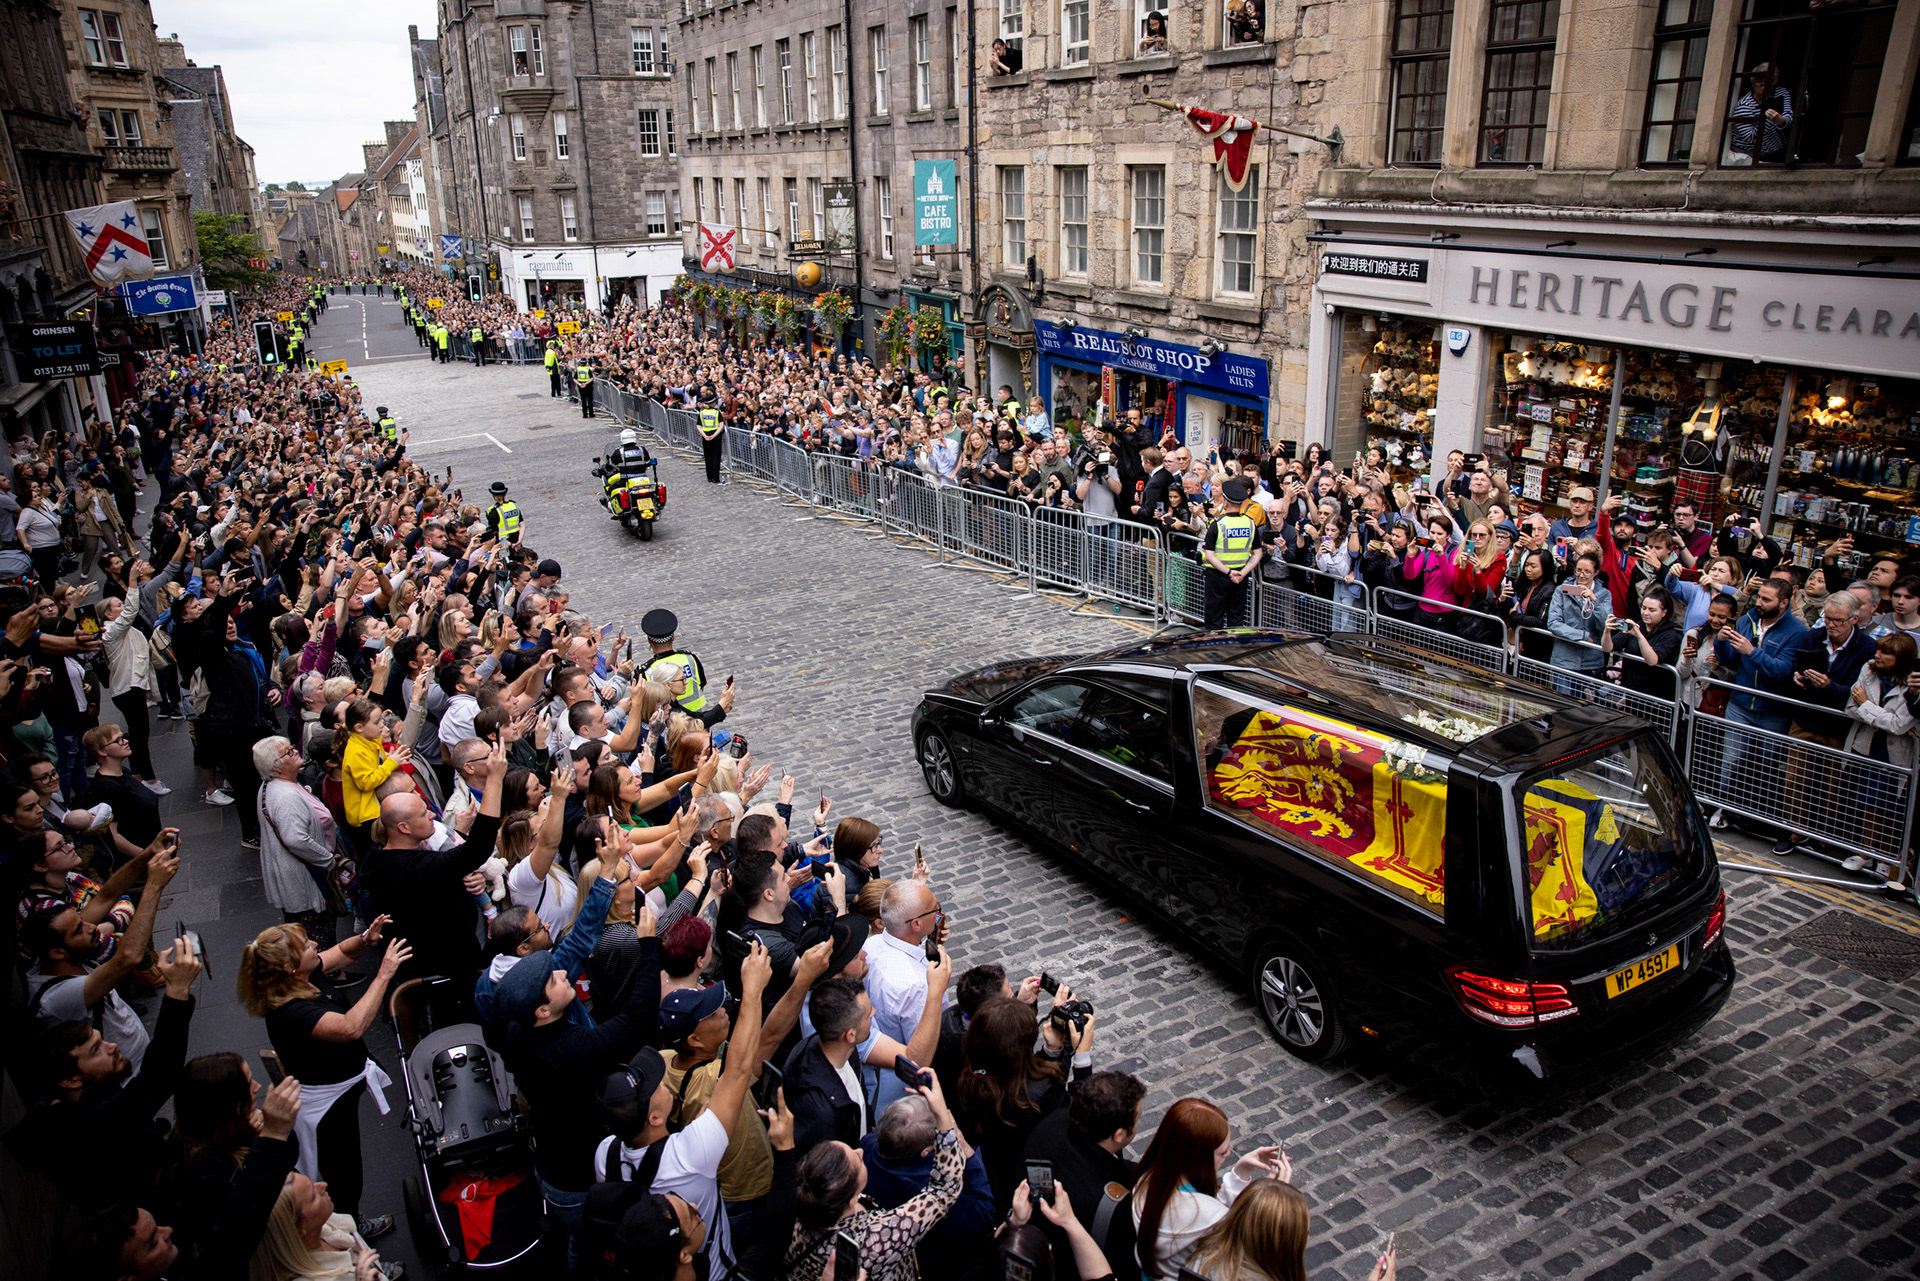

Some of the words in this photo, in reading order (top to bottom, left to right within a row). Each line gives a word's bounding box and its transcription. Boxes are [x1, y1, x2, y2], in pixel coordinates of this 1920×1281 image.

[924, 205, 947, 217] CAFE
[920, 217, 952, 229] BISTRO
[794, 242, 821, 250] BELHAVEN
[529, 258, 574, 273] ragamuffin
[1329, 255, 1420, 278] 欢迎到我们的通关店
[135, 289, 147, 298] The
[147, 282, 169, 292] Scottish
[169, 282, 188, 294] Grocer
[1469, 265, 1737, 331] HERITAGE
[32, 326, 75, 336] ORINSEN
[1042, 329, 1058, 339] KIDS
[1450, 331, 1462, 340] RG
[1043, 338, 1061, 349] KILTS
[32, 346, 54, 358] TO
[56, 344, 83, 356] LET
[1071, 331, 1120, 354] REAL
[1121, 341, 1153, 360] SCOT
[1156, 348, 1211, 374] SHOP
[34, 366, 54, 376] 0131
[56, 365, 73, 374] 374
[75, 363, 91, 372] 1111
[1121, 357, 1158, 372] CASHMERE
[1224, 363, 1256, 378] LADIES
[1229, 375, 1254, 389] KILTS
[1227, 528, 1250, 537] POLICE
[1615, 968, 1634, 992] WP
[1637, 949, 1669, 981] 4597
